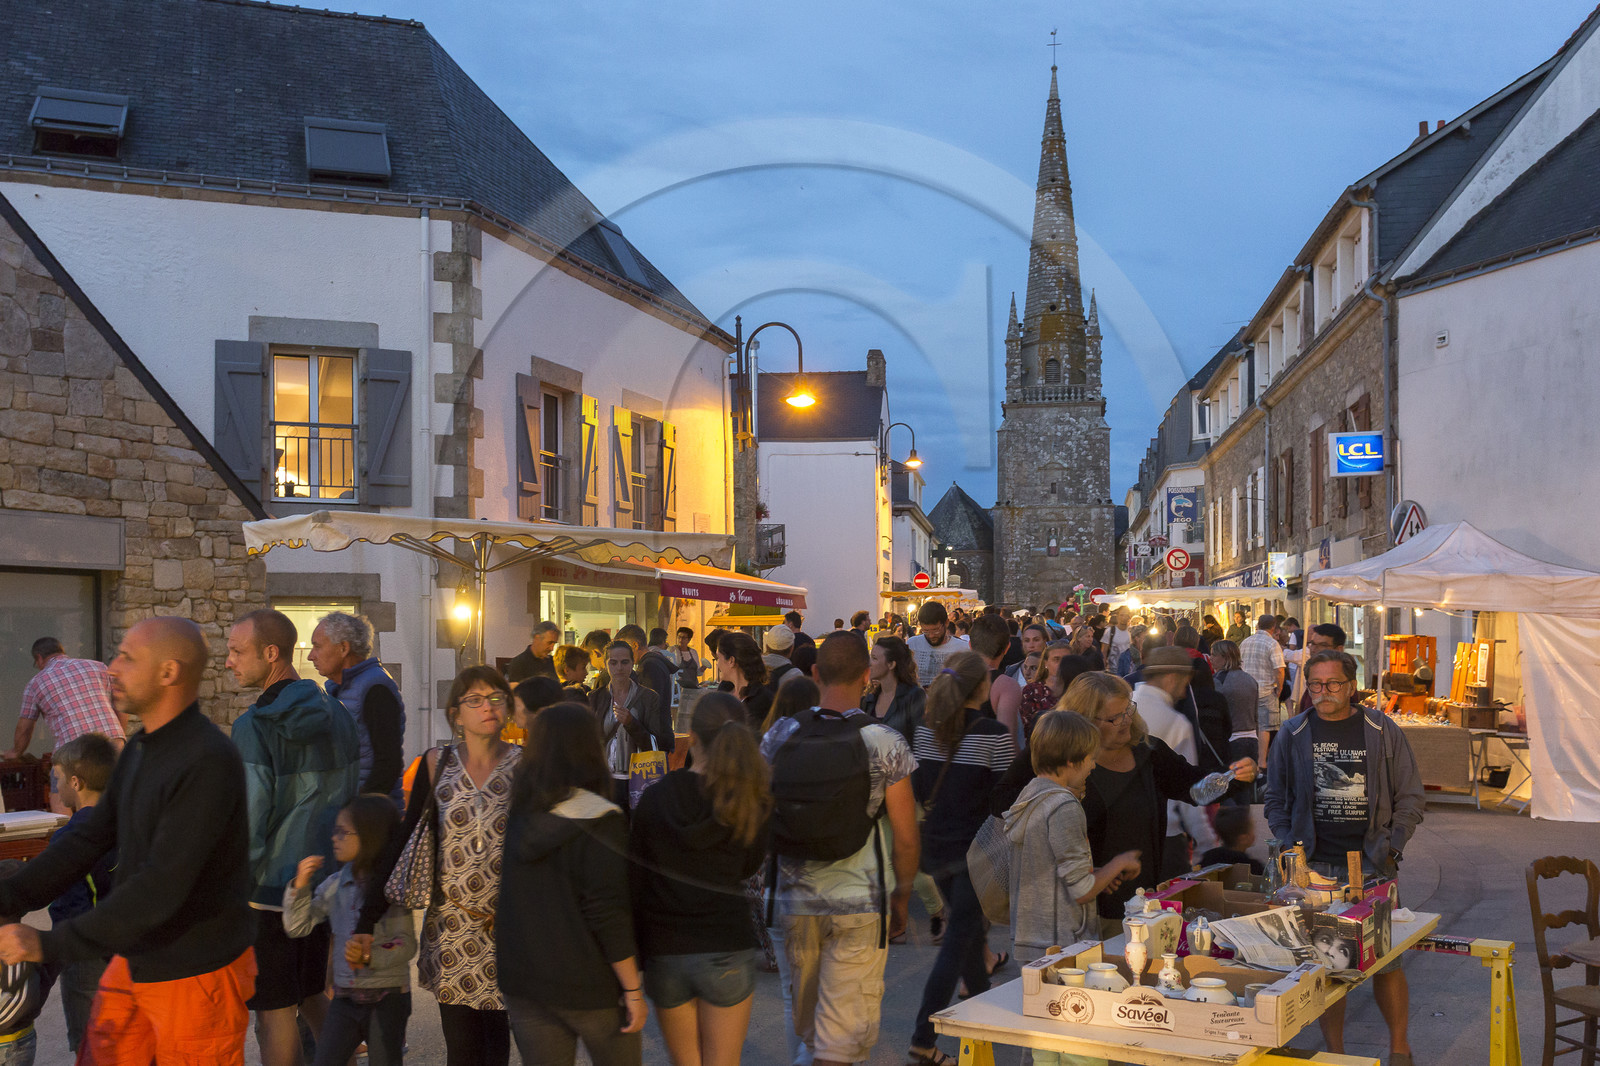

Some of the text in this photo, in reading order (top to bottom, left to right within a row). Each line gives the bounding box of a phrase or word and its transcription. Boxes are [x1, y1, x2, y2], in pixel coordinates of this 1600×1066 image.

[1338, 443, 1378, 456] LCL
[542, 566, 567, 577] FRUITS
[681, 587, 699, 597] FRUITS
[1117, 1005, 1169, 1024] Savéol
